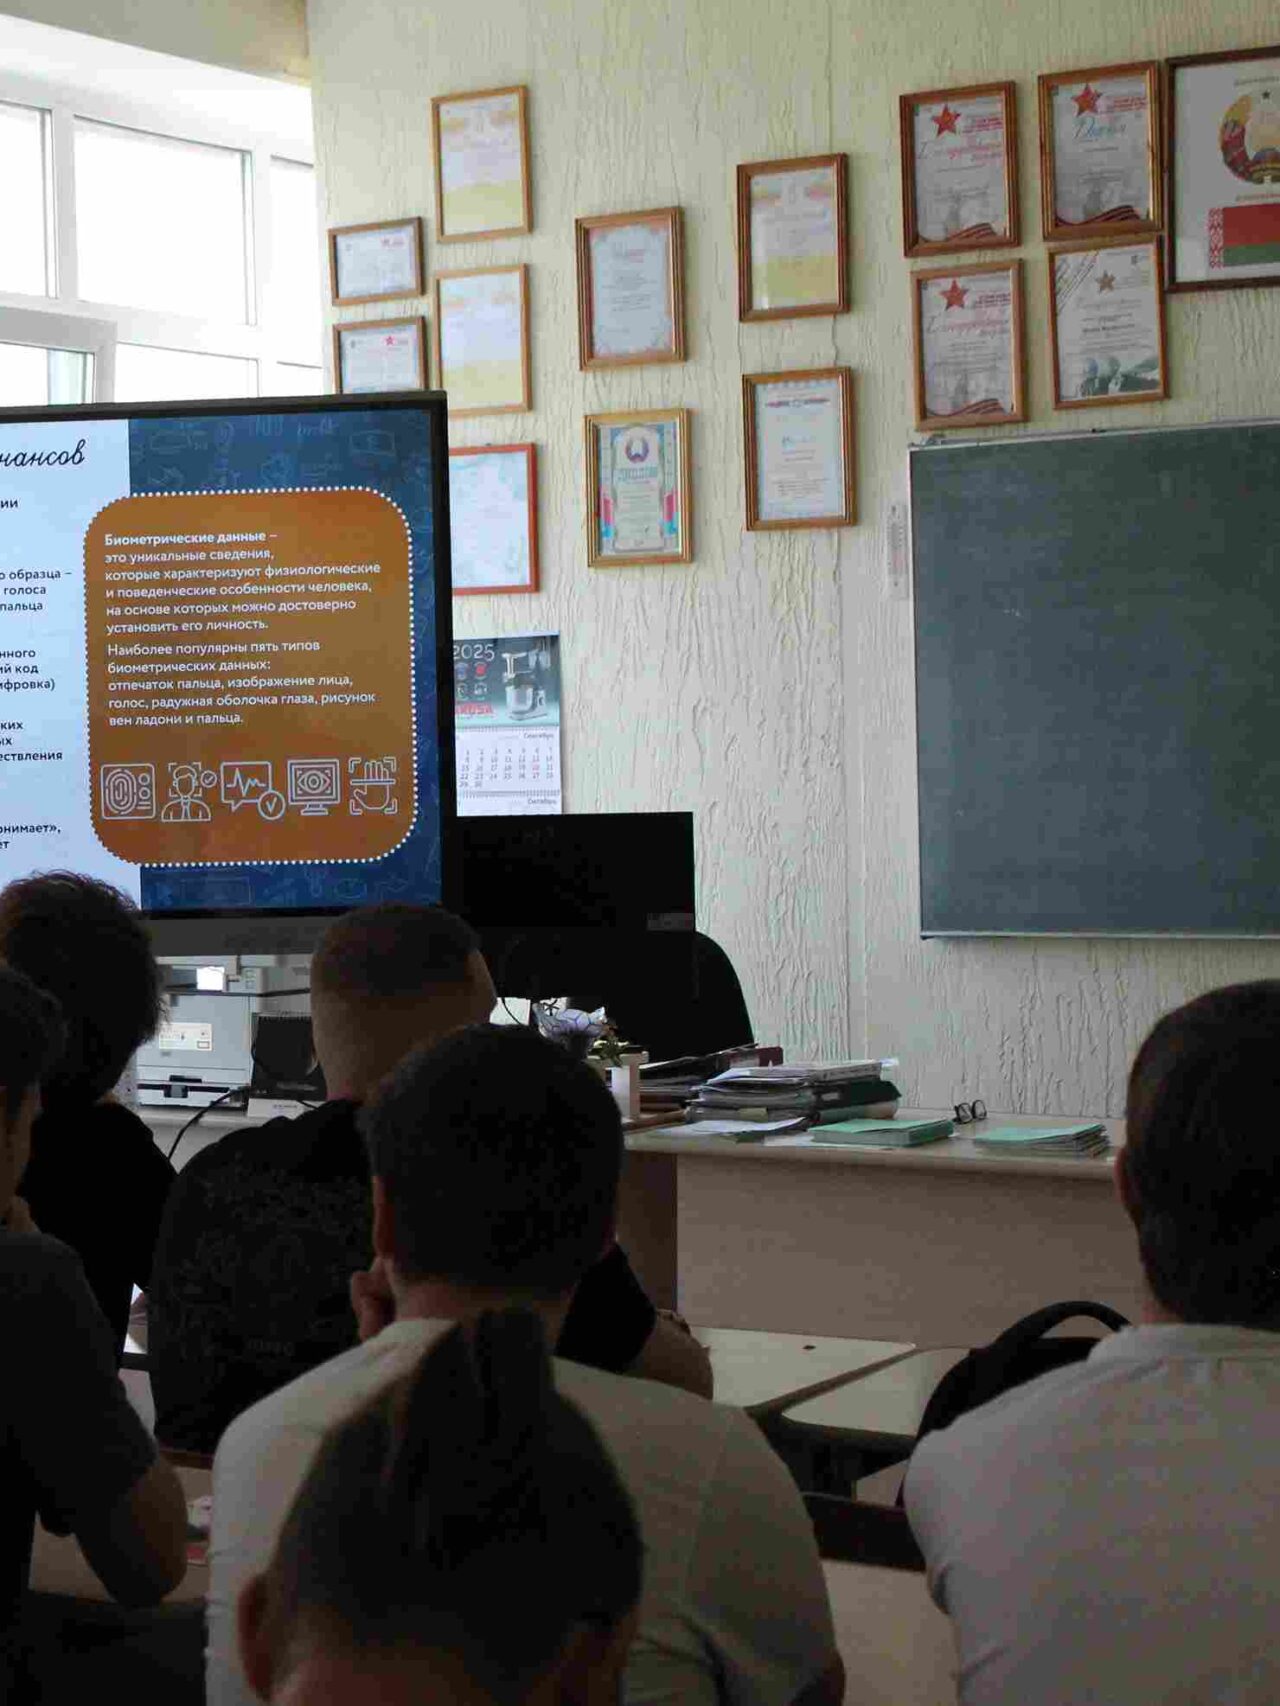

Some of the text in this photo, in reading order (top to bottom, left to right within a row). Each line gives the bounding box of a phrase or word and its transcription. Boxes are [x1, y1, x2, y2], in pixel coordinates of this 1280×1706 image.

[104, 533, 215, 546] Биометрические
[217, 531, 266, 543] данные
[105, 553, 127, 564] это
[129, 550, 207, 562] уникальные
[9, 568, 61, 581] образца
[105, 562, 381, 581] которые характеризуют физиологические
[3, 584, 47, 596] голоса
[106, 588, 114, 597] и
[117, 586, 217, 598] поведенческие
[219, 582, 306, 595] особенности
[0, 601, 43, 613] пальца
[106, 599, 356, 616] на основе которых можно достоверно
[106, 622, 179, 634] установить
[181, 622, 203, 632] его
[108, 640, 320, 656] Наиболее популярны пять типов
[453, 644, 495, 661] 2025
[14, 664, 39, 675] код
[108, 661, 216, 674] биометрических
[108, 679, 174, 691] отпечаток
[227, 675, 316, 688] изображение
[151, 696, 213, 709] радужная
[216, 693, 278, 706] оболочка
[321, 692, 376, 704] рисунок
[109, 715, 132, 726] вен
[134, 714, 182, 726] ладони
[185, 714, 193, 723] и
